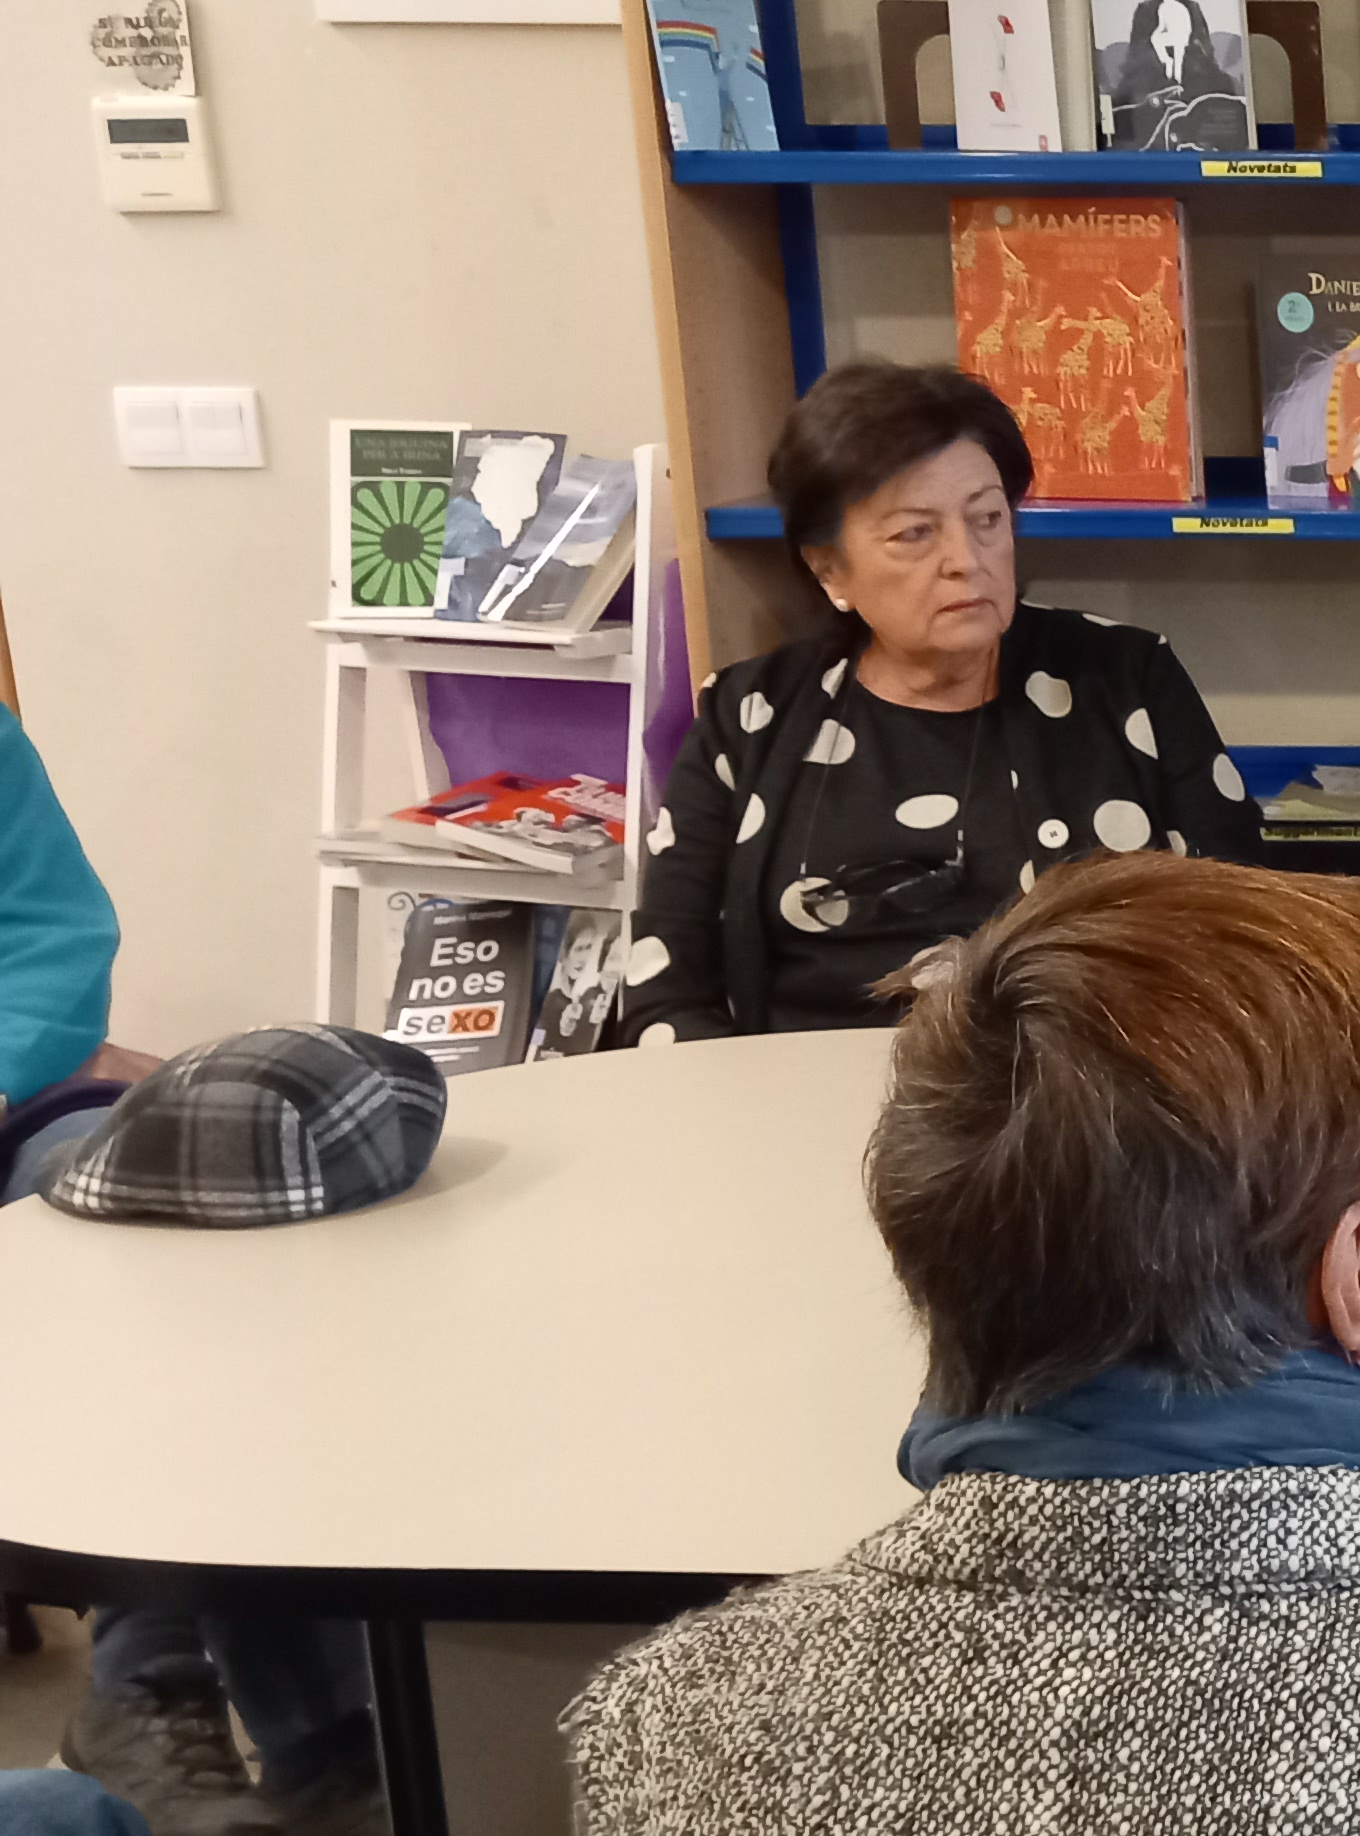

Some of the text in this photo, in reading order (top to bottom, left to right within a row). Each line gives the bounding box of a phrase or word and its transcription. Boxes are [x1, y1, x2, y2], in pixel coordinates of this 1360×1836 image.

[1227, 161, 1297, 173] Novetats
[1018, 207, 1163, 238] MAMÍFERS
[430, 936, 500, 967] Eso
[408, 970, 506, 1001] no es
[402, 1009, 496, 1036] sexo
